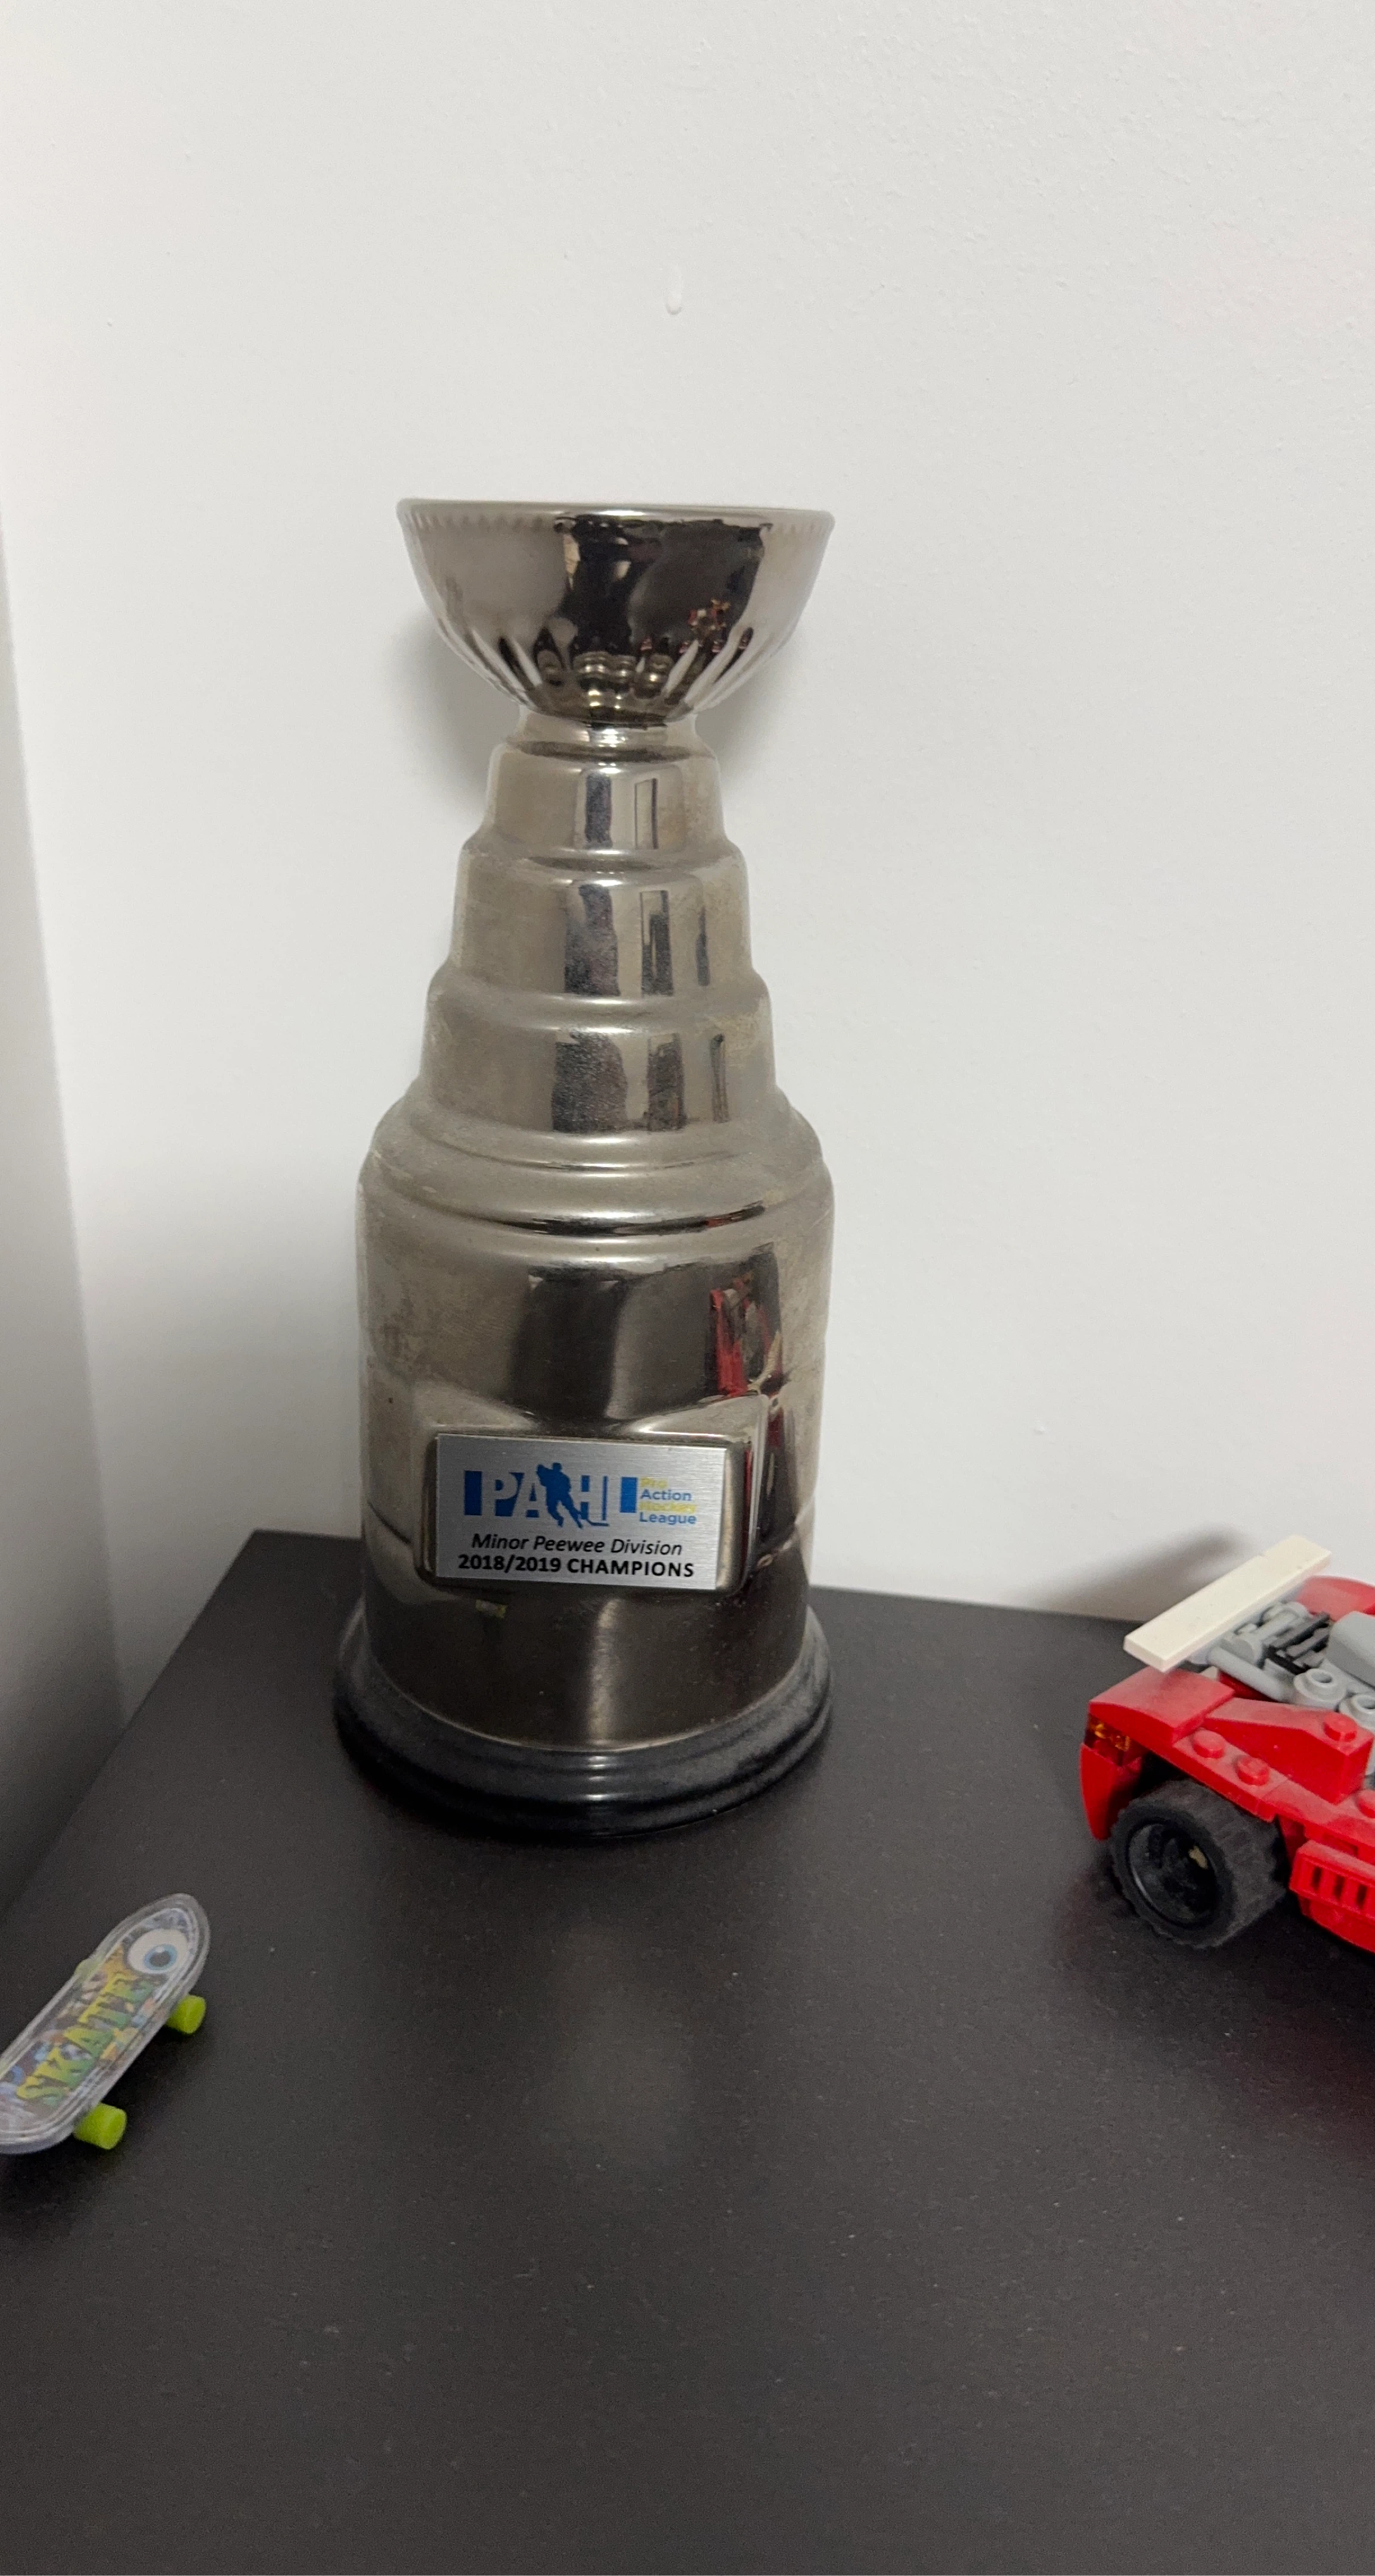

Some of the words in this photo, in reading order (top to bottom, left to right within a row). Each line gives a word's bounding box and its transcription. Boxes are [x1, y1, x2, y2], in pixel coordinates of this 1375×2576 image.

[640, 1477, 668, 1488] Pro
[640, 1489, 692, 1501] Action
[639, 1512, 697, 1525] League
[472, 1533, 529, 1550] Minor
[534, 1535, 605, 1553] Peewee
[611, 1538, 683, 1556] Division
[458, 1554, 561, 1576] 2018/2019
[568, 1559, 695, 1577] CHAMPIONS
[16, 1972, 154, 2106] SKATE
